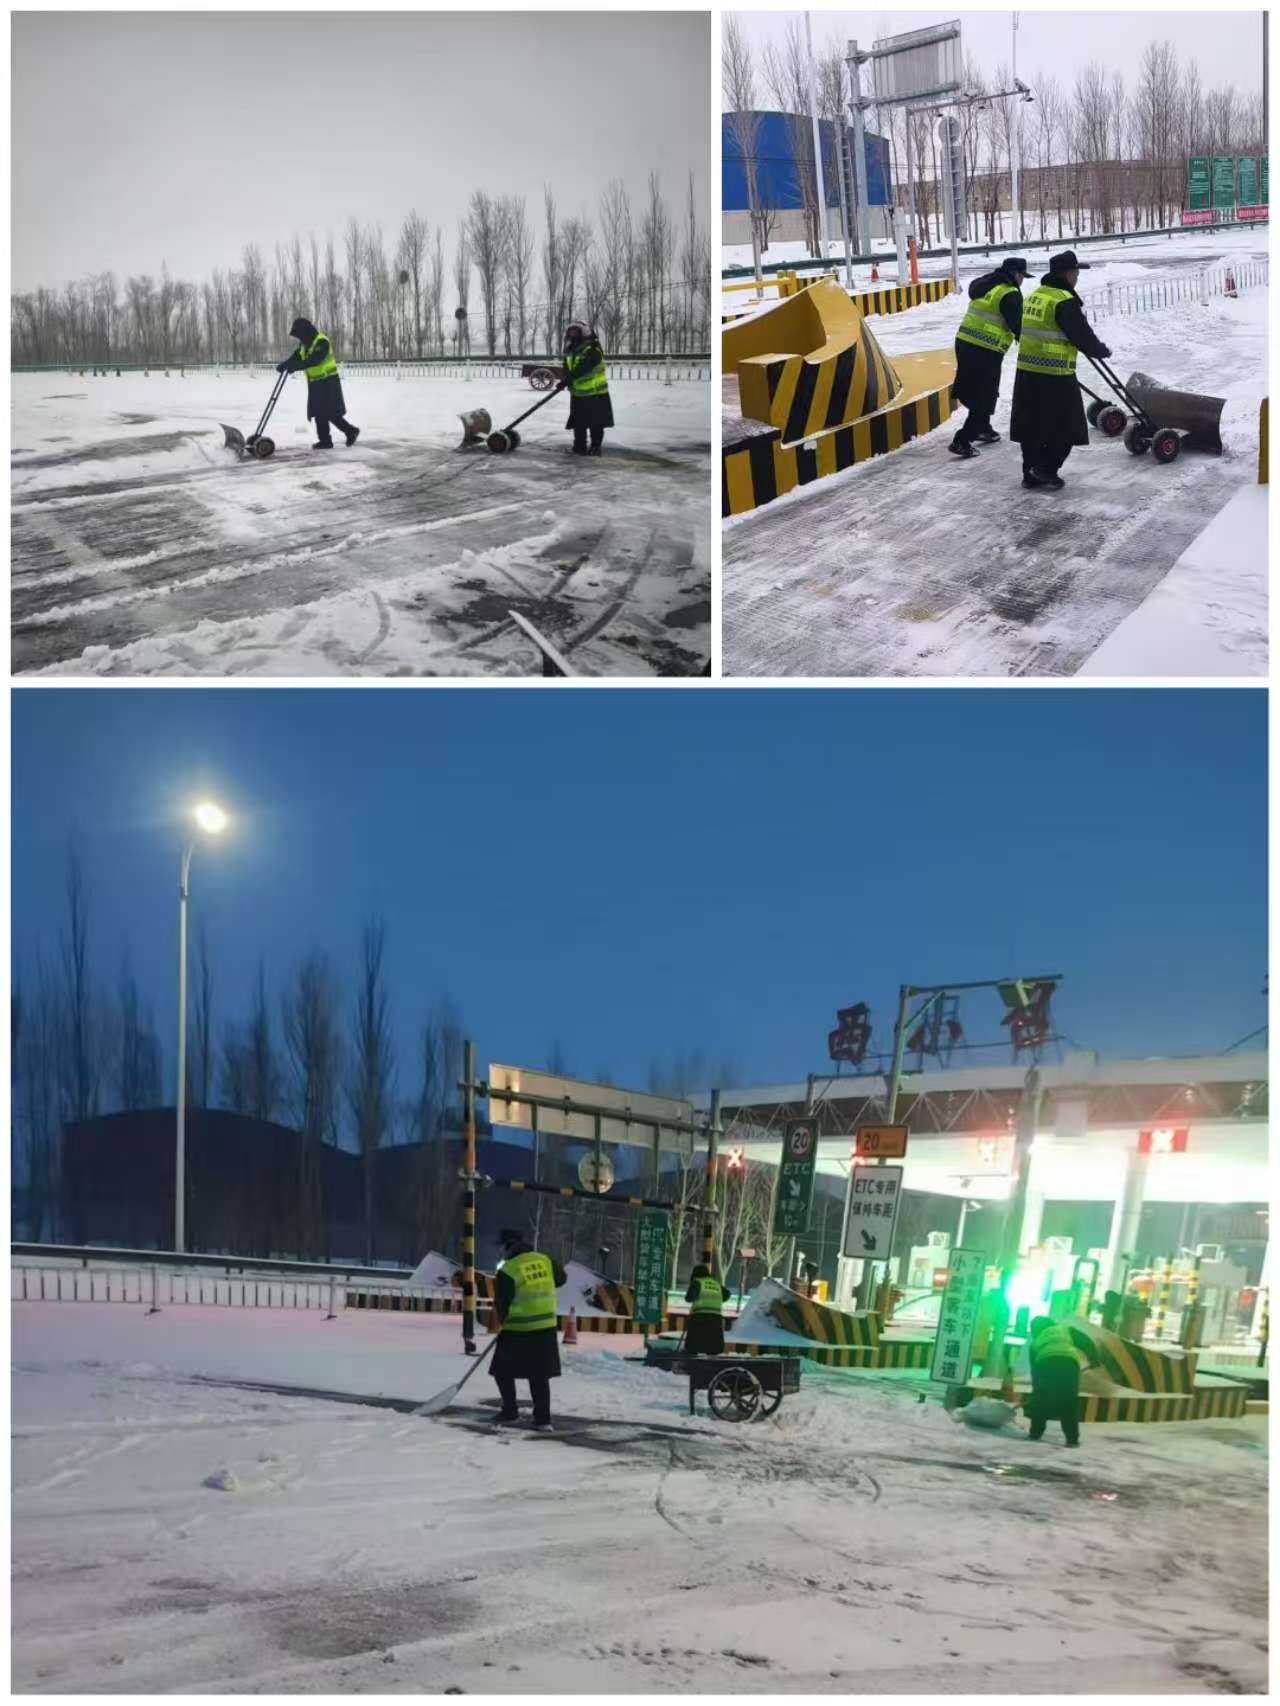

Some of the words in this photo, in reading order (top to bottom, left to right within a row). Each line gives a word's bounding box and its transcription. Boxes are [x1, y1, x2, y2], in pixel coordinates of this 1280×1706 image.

[793, 1131, 809, 1151] 20
[864, 1132, 879, 1152] 20
[783, 1162, 811, 1175] ETC
[855, 1179, 897, 1195] ETC专用
